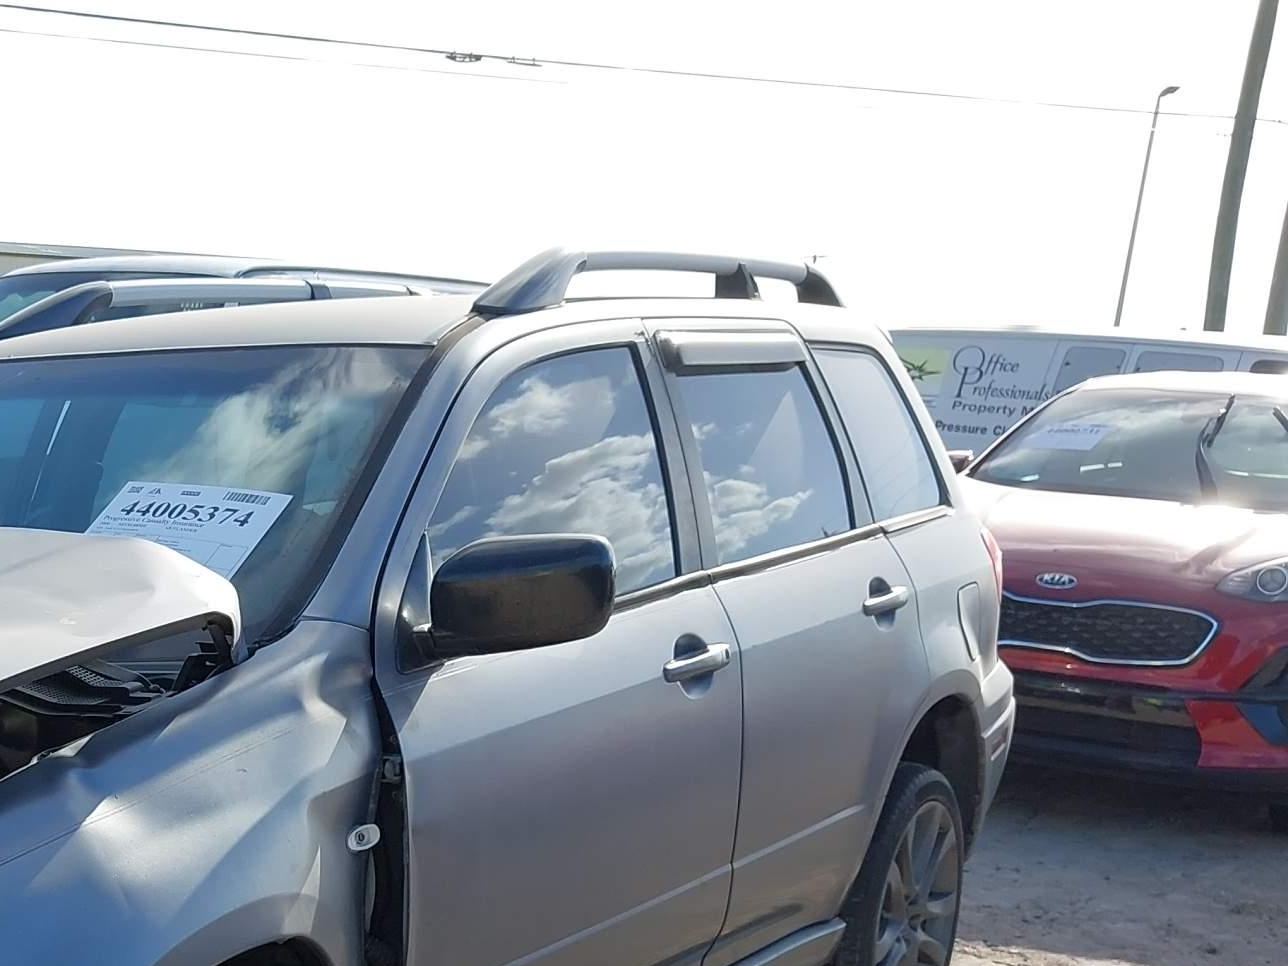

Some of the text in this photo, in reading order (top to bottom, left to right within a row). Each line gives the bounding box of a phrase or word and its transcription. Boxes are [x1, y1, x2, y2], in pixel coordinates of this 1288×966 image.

[952, 345, 1020, 375] Office
[956, 366, 1050, 401] Professionals
[951, 399, 1016, 418] Property
[935, 419, 988, 435] Pressure
[120, 499, 255, 527] 44005374
